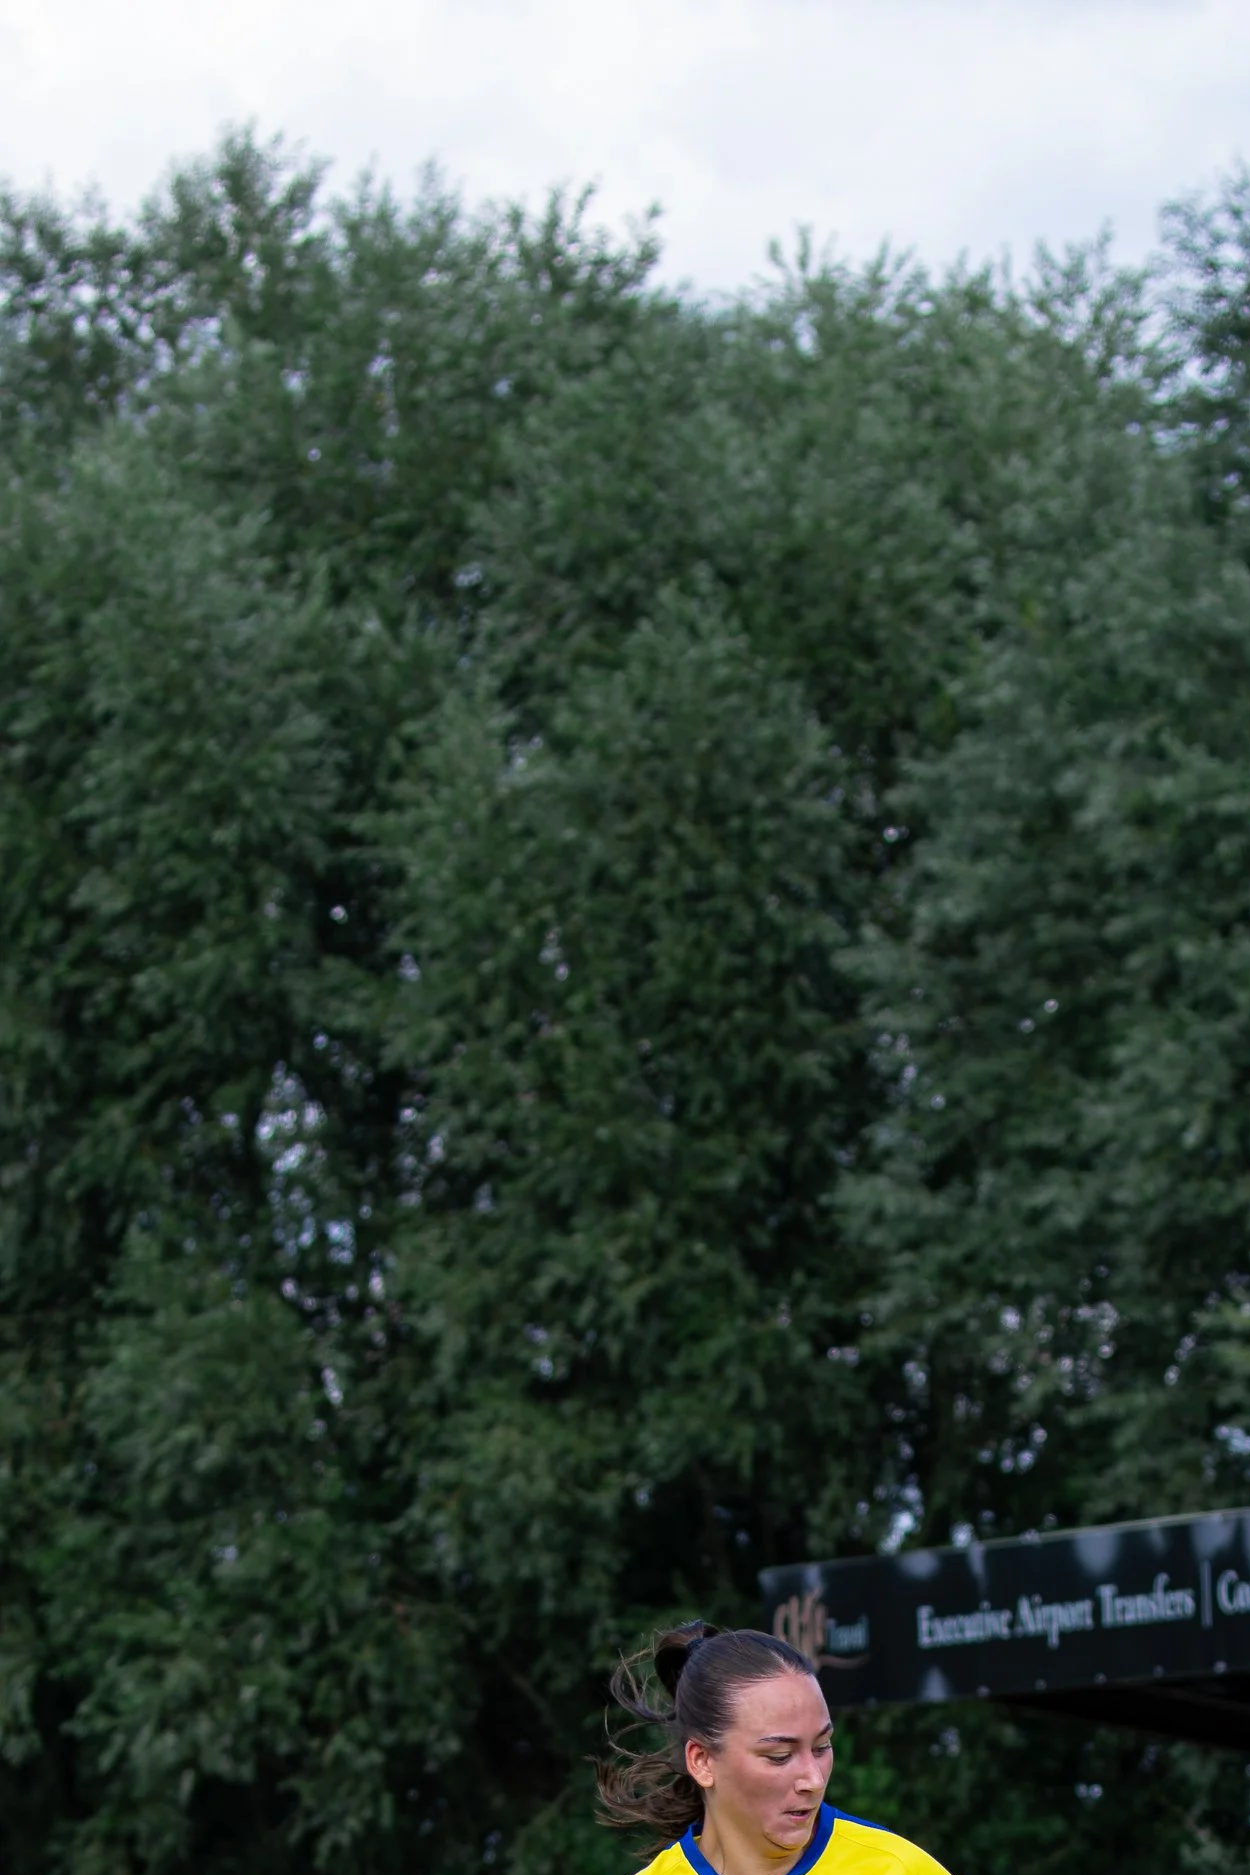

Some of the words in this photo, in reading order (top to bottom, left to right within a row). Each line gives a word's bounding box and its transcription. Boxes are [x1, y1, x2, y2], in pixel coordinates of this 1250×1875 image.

[917, 1601, 1011, 1649] Executive
[1013, 1594, 1093, 1648] Airport
[1099, 1572, 1196, 1625] Transfers
